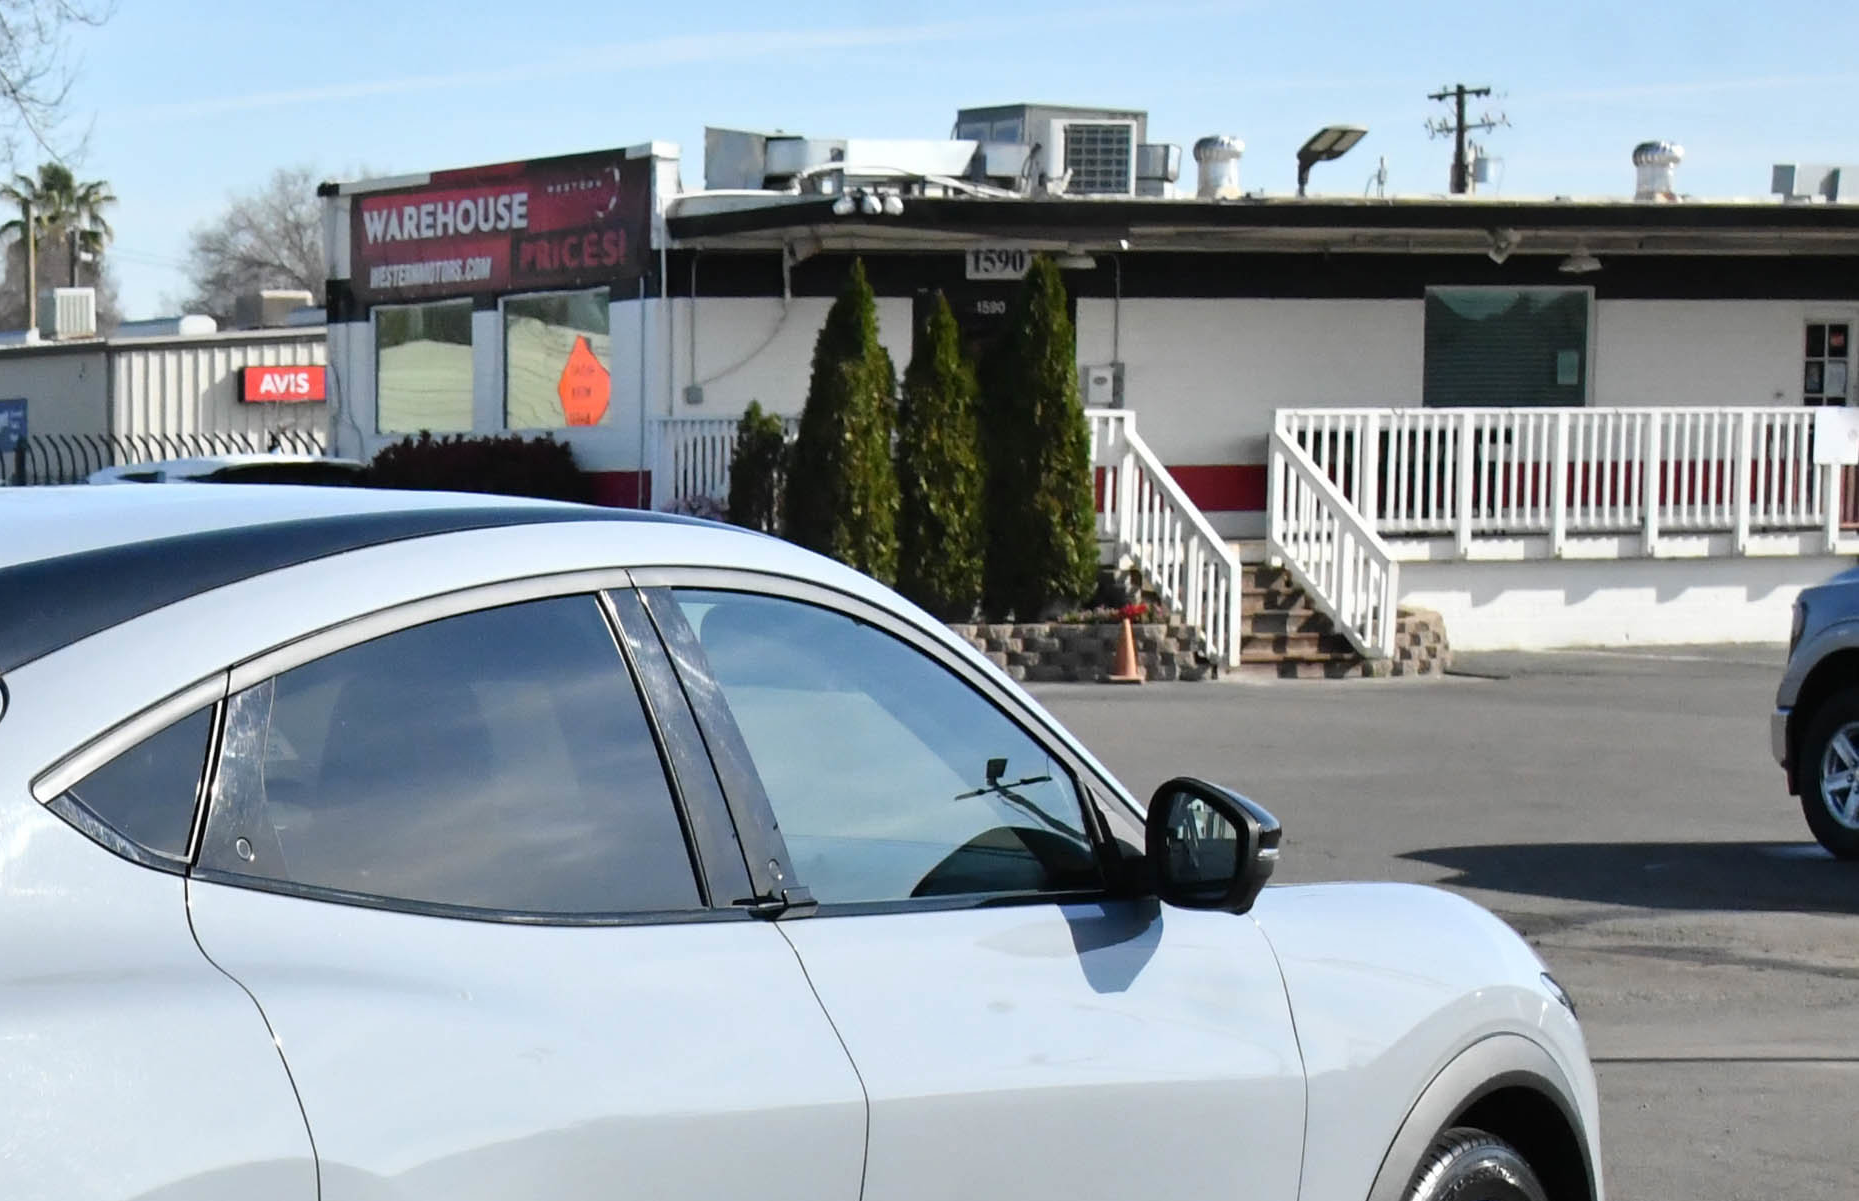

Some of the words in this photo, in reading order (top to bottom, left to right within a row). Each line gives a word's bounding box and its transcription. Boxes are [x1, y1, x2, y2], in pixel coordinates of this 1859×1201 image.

[363, 192, 529, 245] WAREHOUSE
[519, 228, 627, 270] PRICES!
[973, 248, 1025, 273] 1590
[369, 256, 492, 289] WESTERNMOTORS.COM
[260, 372, 310, 395] AVIS
